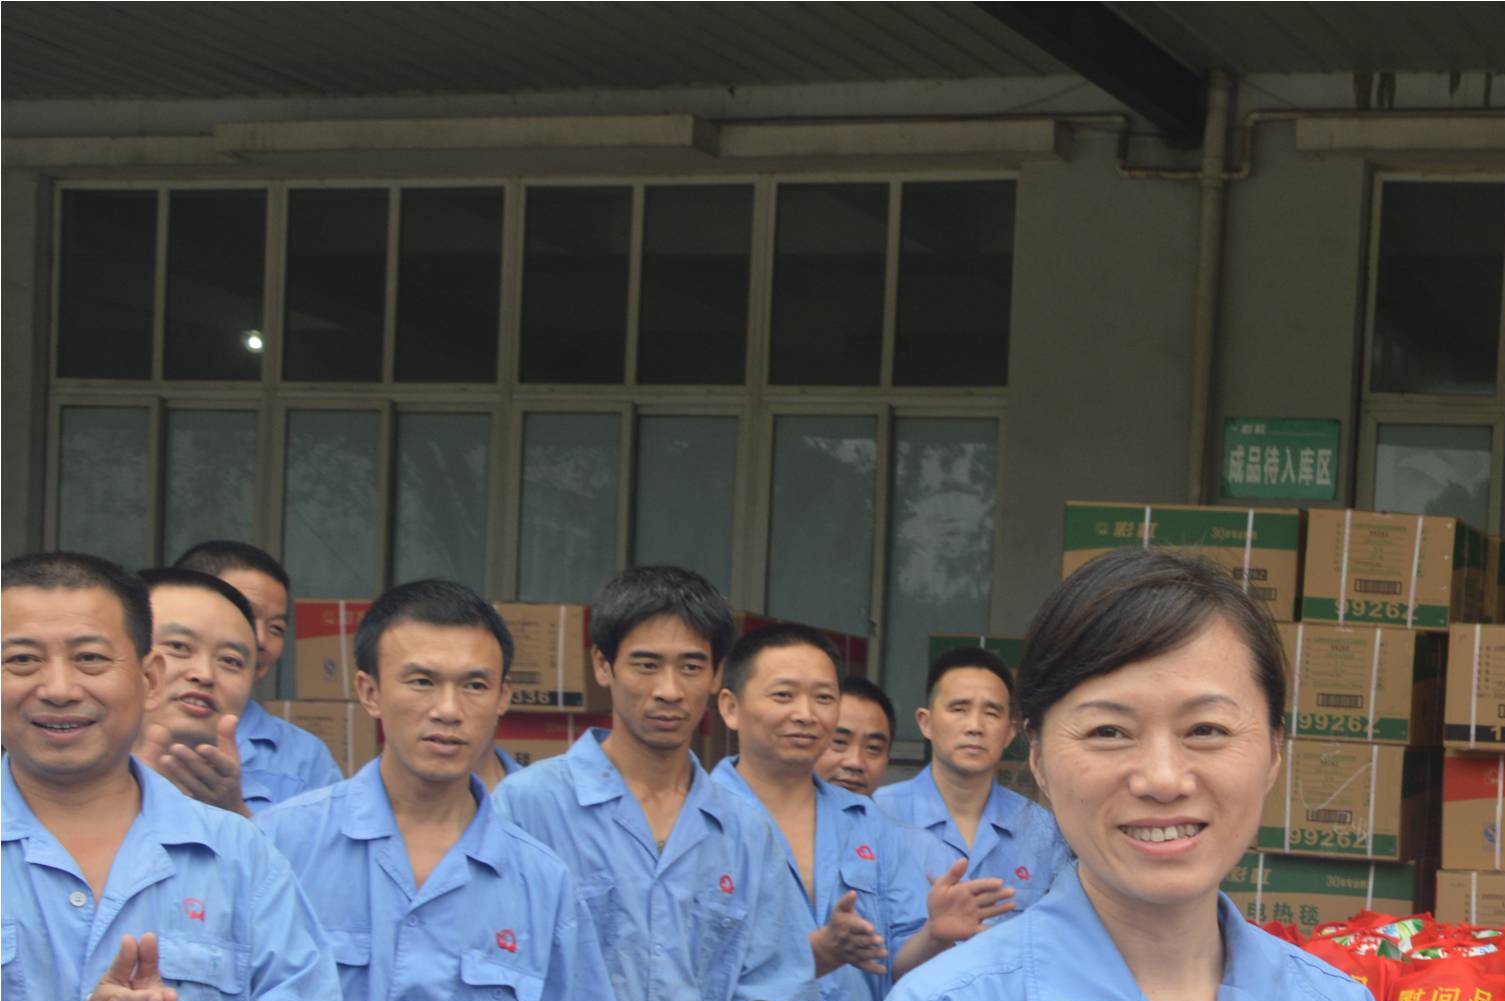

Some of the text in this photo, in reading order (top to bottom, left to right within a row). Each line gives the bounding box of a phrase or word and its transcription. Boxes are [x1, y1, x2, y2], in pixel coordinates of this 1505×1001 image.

[1228, 445, 1332, 485] 成品待入库区
[512, 690, 551, 704] 336
